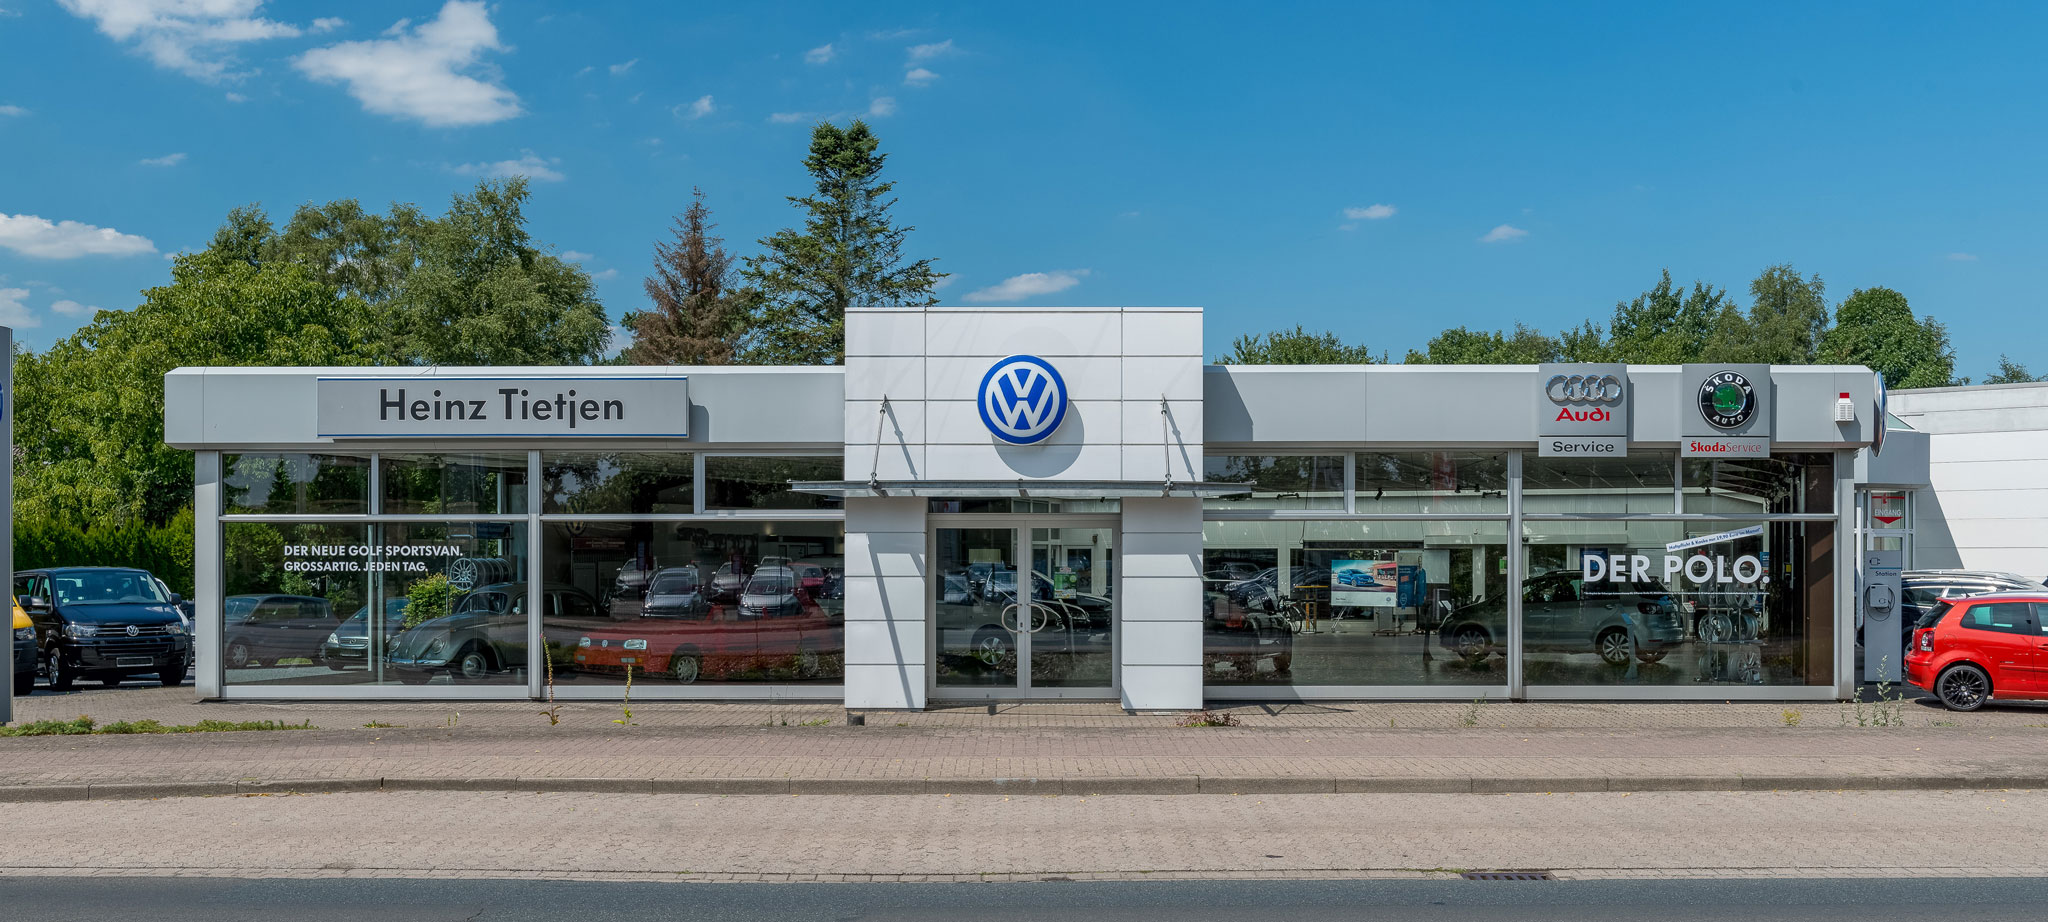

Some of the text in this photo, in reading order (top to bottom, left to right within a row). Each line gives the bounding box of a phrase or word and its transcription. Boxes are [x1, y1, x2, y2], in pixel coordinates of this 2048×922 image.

[380, 388, 624, 429] Heinz Tietjen
[1555, 407, 1610, 422] Audi
[1713, 414, 1744, 424] AUTO
[1552, 440, 1614, 453] Service
[1690, 440, 1762, 453] ŠkodaService
[1874, 508, 1902, 516] EINGANG
[284, 545, 463, 557] DER NEUE GOLF SPORTSVAN.
[284, 561, 429, 572] GROSSARTIG. JEDEN TAG.
[1583, 554, 1770, 584] DER POLO.
